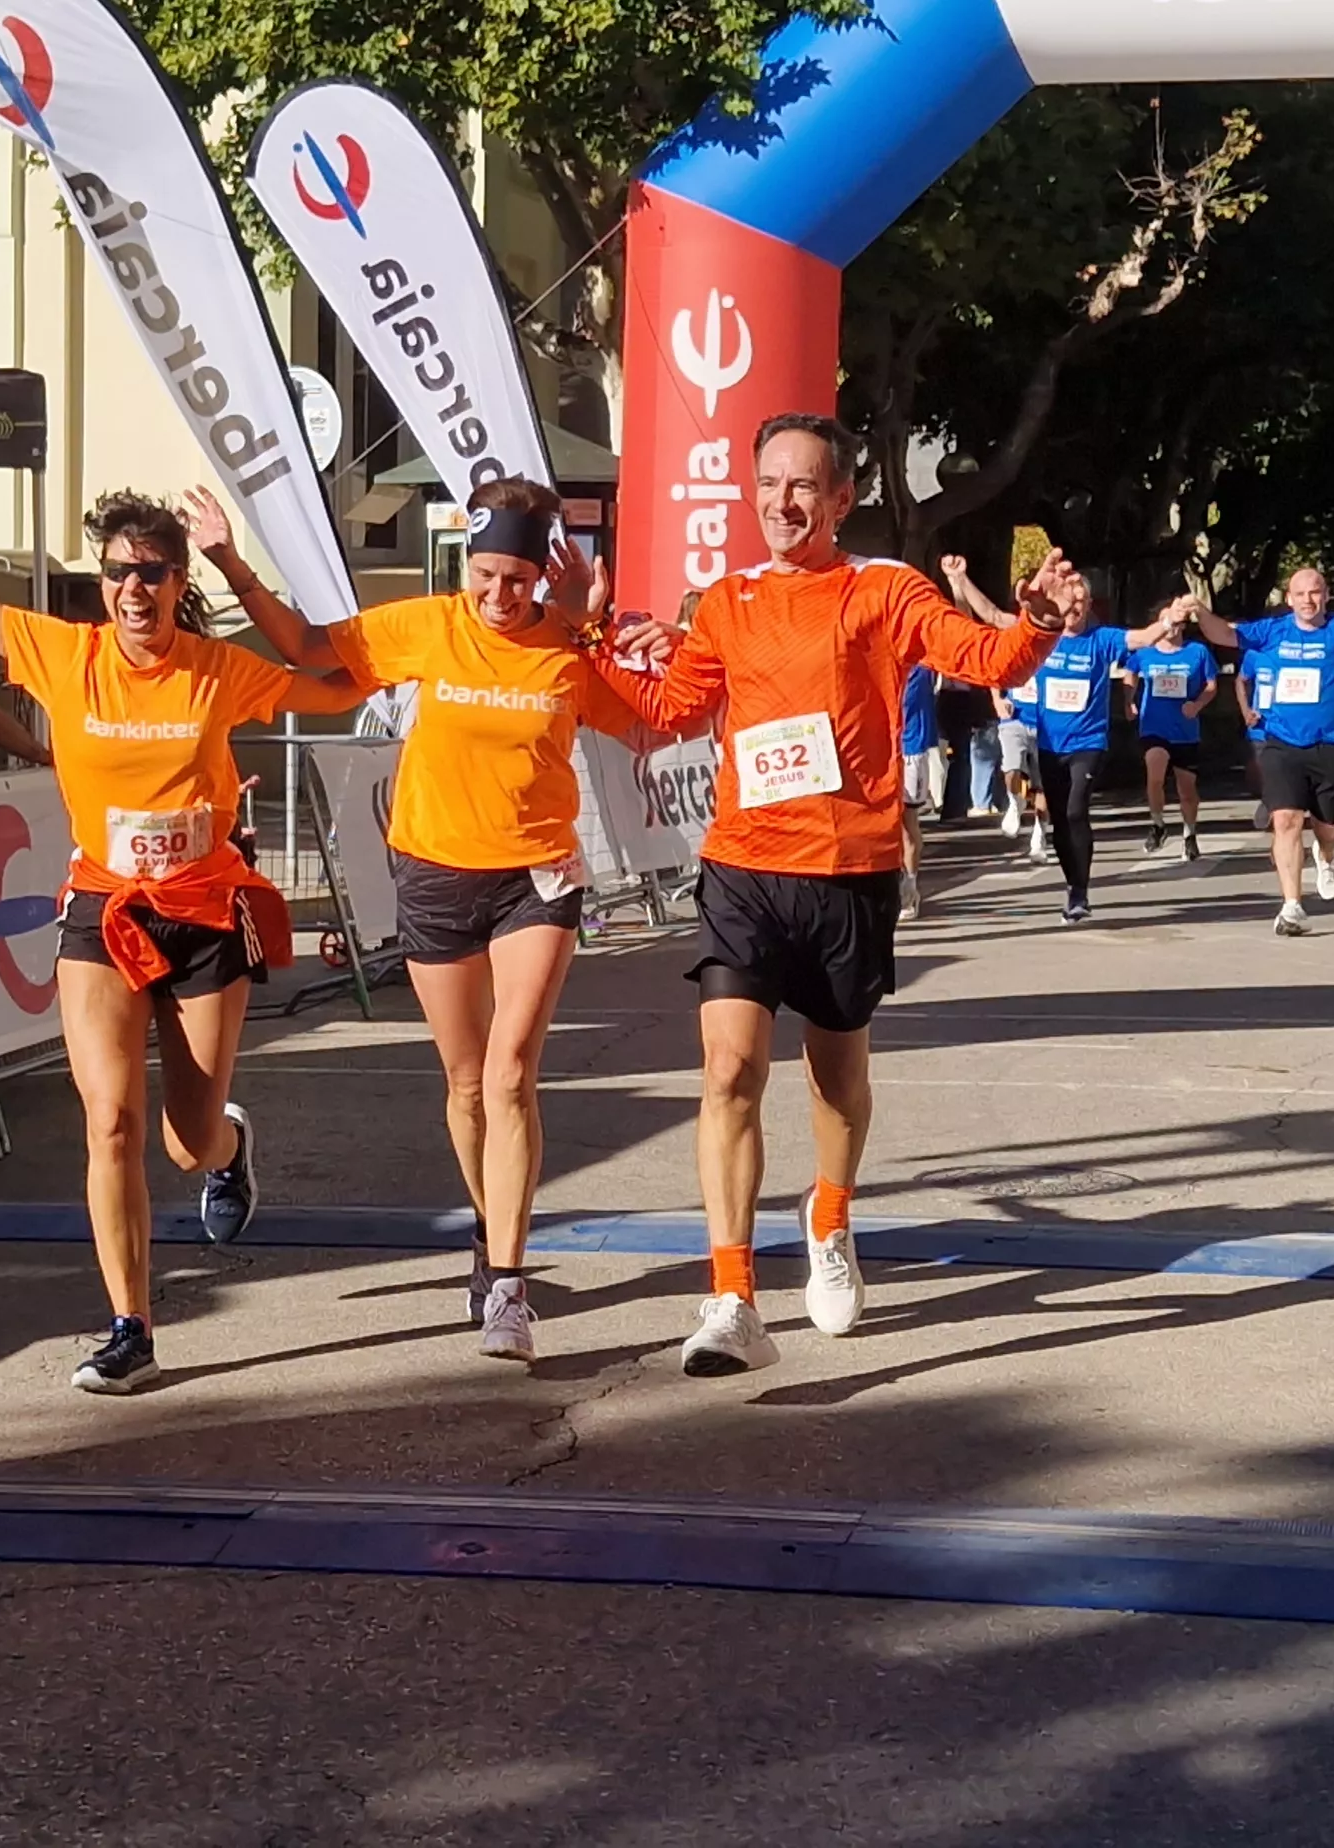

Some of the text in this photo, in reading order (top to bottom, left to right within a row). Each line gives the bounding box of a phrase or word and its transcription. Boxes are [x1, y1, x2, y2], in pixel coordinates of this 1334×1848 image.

[671, 437, 743, 590] caja
[435, 677, 571, 714] bankinte
[754, 744, 810, 775] 632
[130, 832, 188, 855] 630
